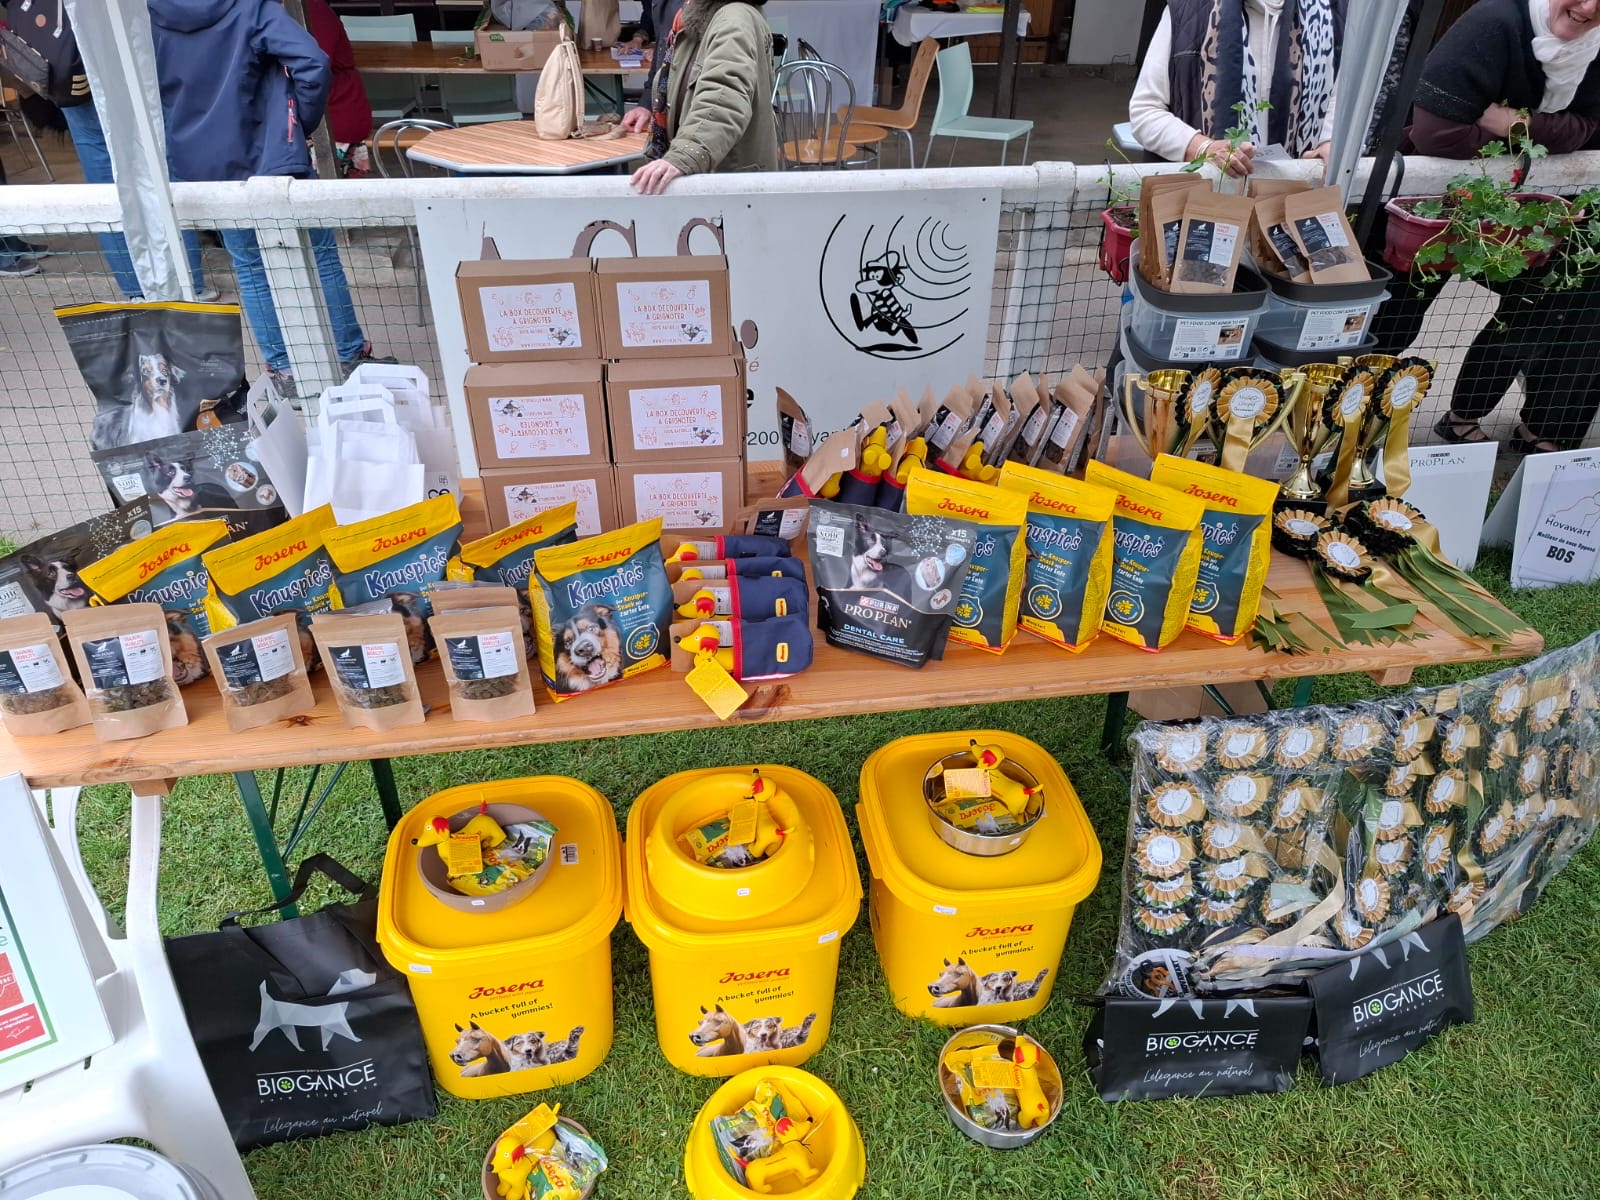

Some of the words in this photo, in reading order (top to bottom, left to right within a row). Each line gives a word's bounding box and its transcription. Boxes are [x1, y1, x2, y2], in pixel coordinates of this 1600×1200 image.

[499, 310, 508, 318] LA
[509, 308, 522, 317] BOX
[634, 305, 642, 313] LA
[643, 304, 656, 313] BOX
[652, 312, 685, 321] GRIGNOTER
[518, 316, 552, 325] GRIGNOTER
[655, 409, 668, 417] BOX
[664, 416, 697, 425] GRIGNOTER
[519, 420, 553, 429] GRIGNOTER
[549, 427, 562, 435] BOX
[747, 430, 779, 446] 200
[1028, 491, 1078, 515] Josera
[1183, 483, 1239, 508] Josera
[126, 505, 142, 518] x15
[937, 497, 991, 519] Josera
[1115, 494, 1163, 521] Josera
[227, 521, 248, 534] AN
[951, 528, 968, 538] x15
[1544, 516, 1592, 538] Hovawart
[371, 526, 428, 553] Josera
[493, 524, 545, 551] Josera
[138, 542, 192, 580] Josera
[254, 539, 308, 572] Josera
[576, 546, 632, 568] Josera
[1546, 545, 1576, 564] BOS
[364, 546, 448, 598] Knuspies
[127, 570, 209, 604] Knuspie
[250, 563, 332, 618] Knuspies
[567, 559, 644, 610] Knuspies
[620, 607, 638, 618] zarter
[638, 603, 651, 612] Ente
[870, 599, 899, 612] PURINA
[844, 603, 874, 620] PRO
[874, 610, 909, 629] PLAN
[844, 623, 878, 638] DENTAL
[879, 634, 906, 644] CARE
[959, 802, 996, 821] Josera
[706, 834, 729, 854] sera
[964, 923, 1035, 938] Josera
[968, 945, 997, 956] bucket
[998, 942, 1012, 951] full
[1013, 940, 1024, 948] of
[995, 945, 1035, 958] gummies!
[719, 967, 791, 984] Josera
[468, 979, 545, 1000] Josera
[725, 990, 755, 1002] bucket
[756, 986, 771, 997] full
[771, 985, 783, 993] of
[754, 990, 795, 1005] gummies!
[1352, 973, 1445, 1024] BIOGANCE
[470, 1012, 478, 1020] A
[478, 1005, 510, 1018] bucket
[511, 1000, 527, 1010] full
[528, 997, 539, 1006] of
[510, 1002, 554, 1020] gummies!
[1145, 1032, 1259, 1052] BIOGANCE
[256, 1062, 377, 1097] BIOGANCE
[1198, 1069, 1214, 1078] au
[1216, 1062, 1254, 1079] naturel
[322, 1116, 338, 1125] au
[342, 1100, 383, 1123] naturel
